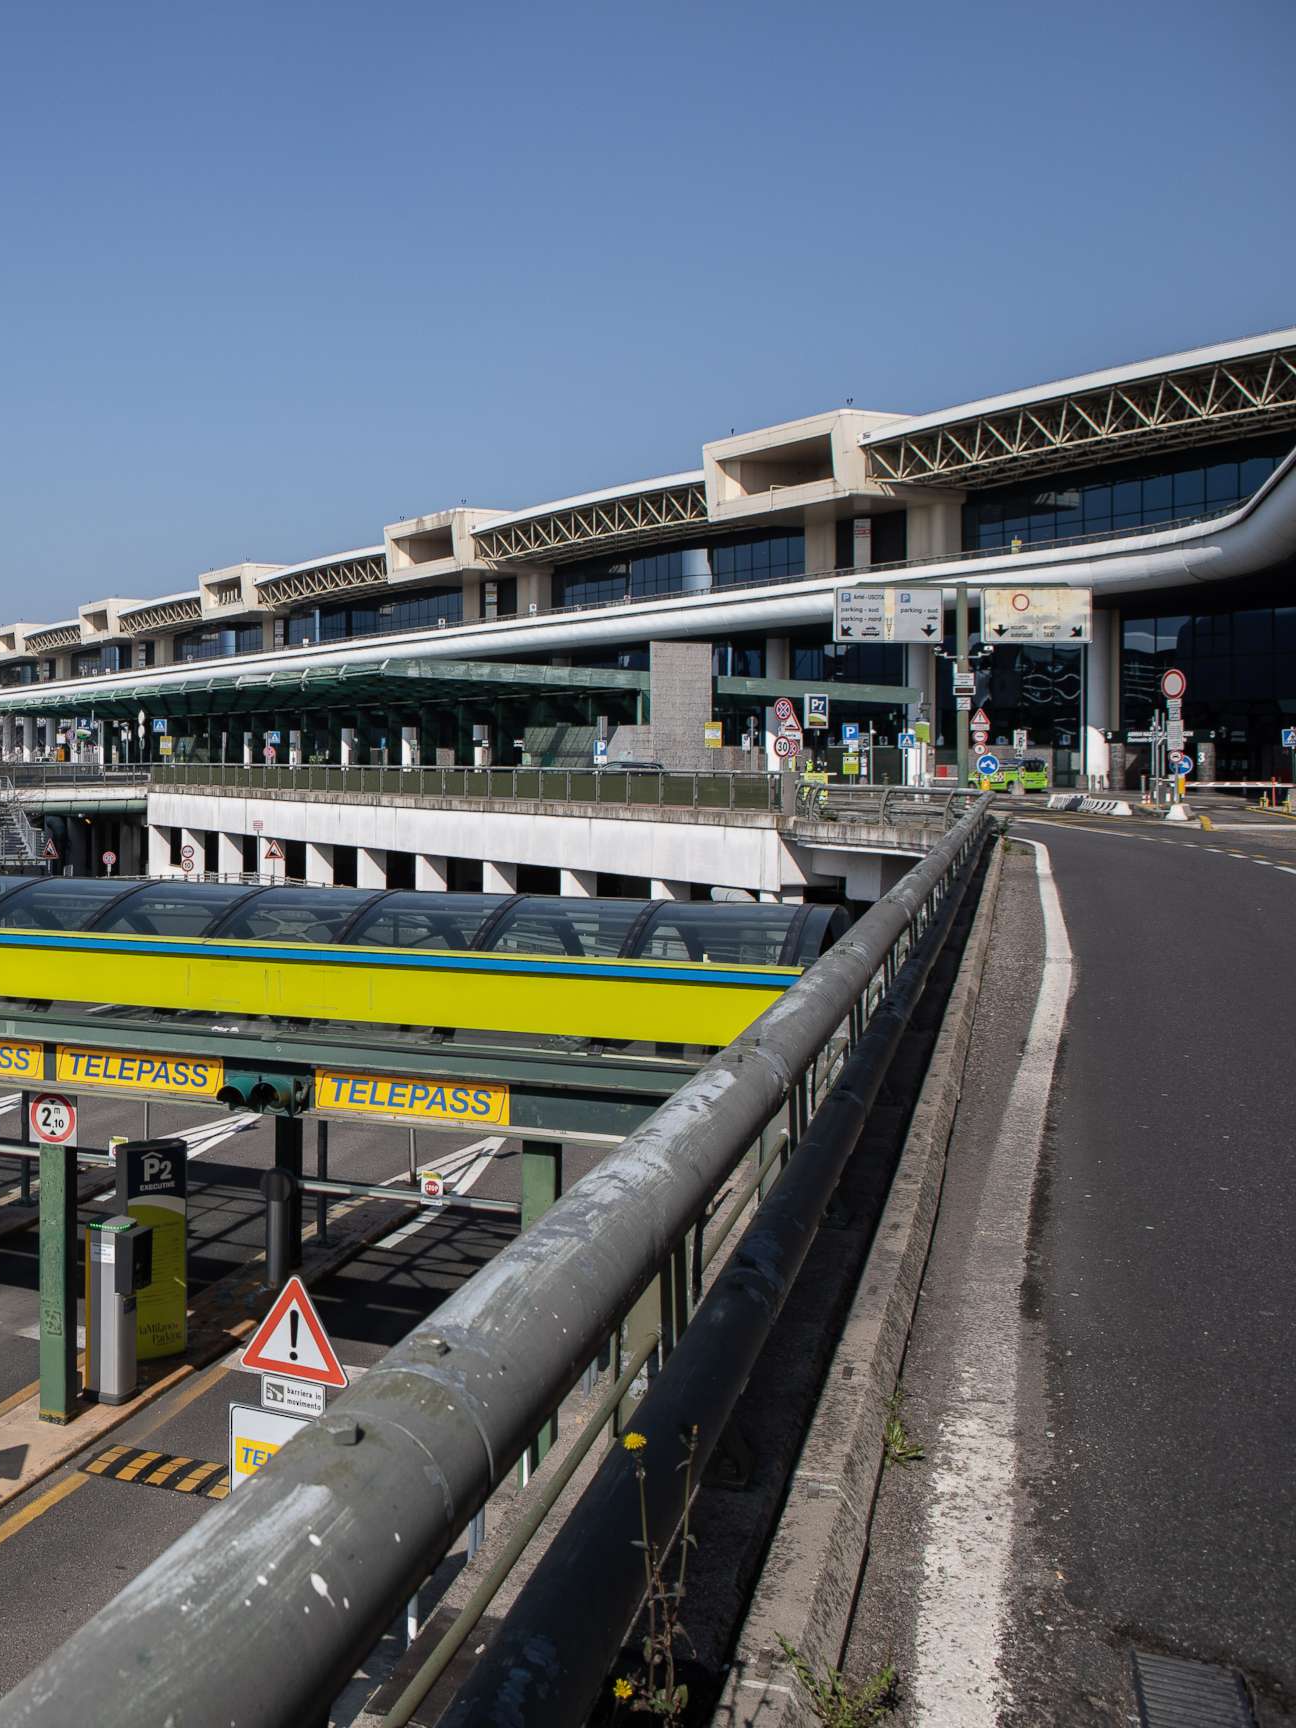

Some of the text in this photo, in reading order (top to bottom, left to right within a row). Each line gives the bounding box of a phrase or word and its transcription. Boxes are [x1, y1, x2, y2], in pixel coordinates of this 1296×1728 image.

[811, 699, 824, 710] P7
[846, 727, 855, 737] P
[1209, 730, 1216, 738] 3
[597, 741, 605, 754] P
[777, 742, 787, 752] 30
[1198, 752, 1205, 762] 3
[70, 1053, 209, 1087] TELEPASS
[330, 1078, 492, 1115] TELEPASS
[143, 1158, 173, 1181] P2
[139, 1180, 176, 1192] EXECUTIVE
[425, 1184, 439, 1192] STOP
[287, 1387, 322, 1400] barriera in
[287, 1399, 321, 1411] movimento
